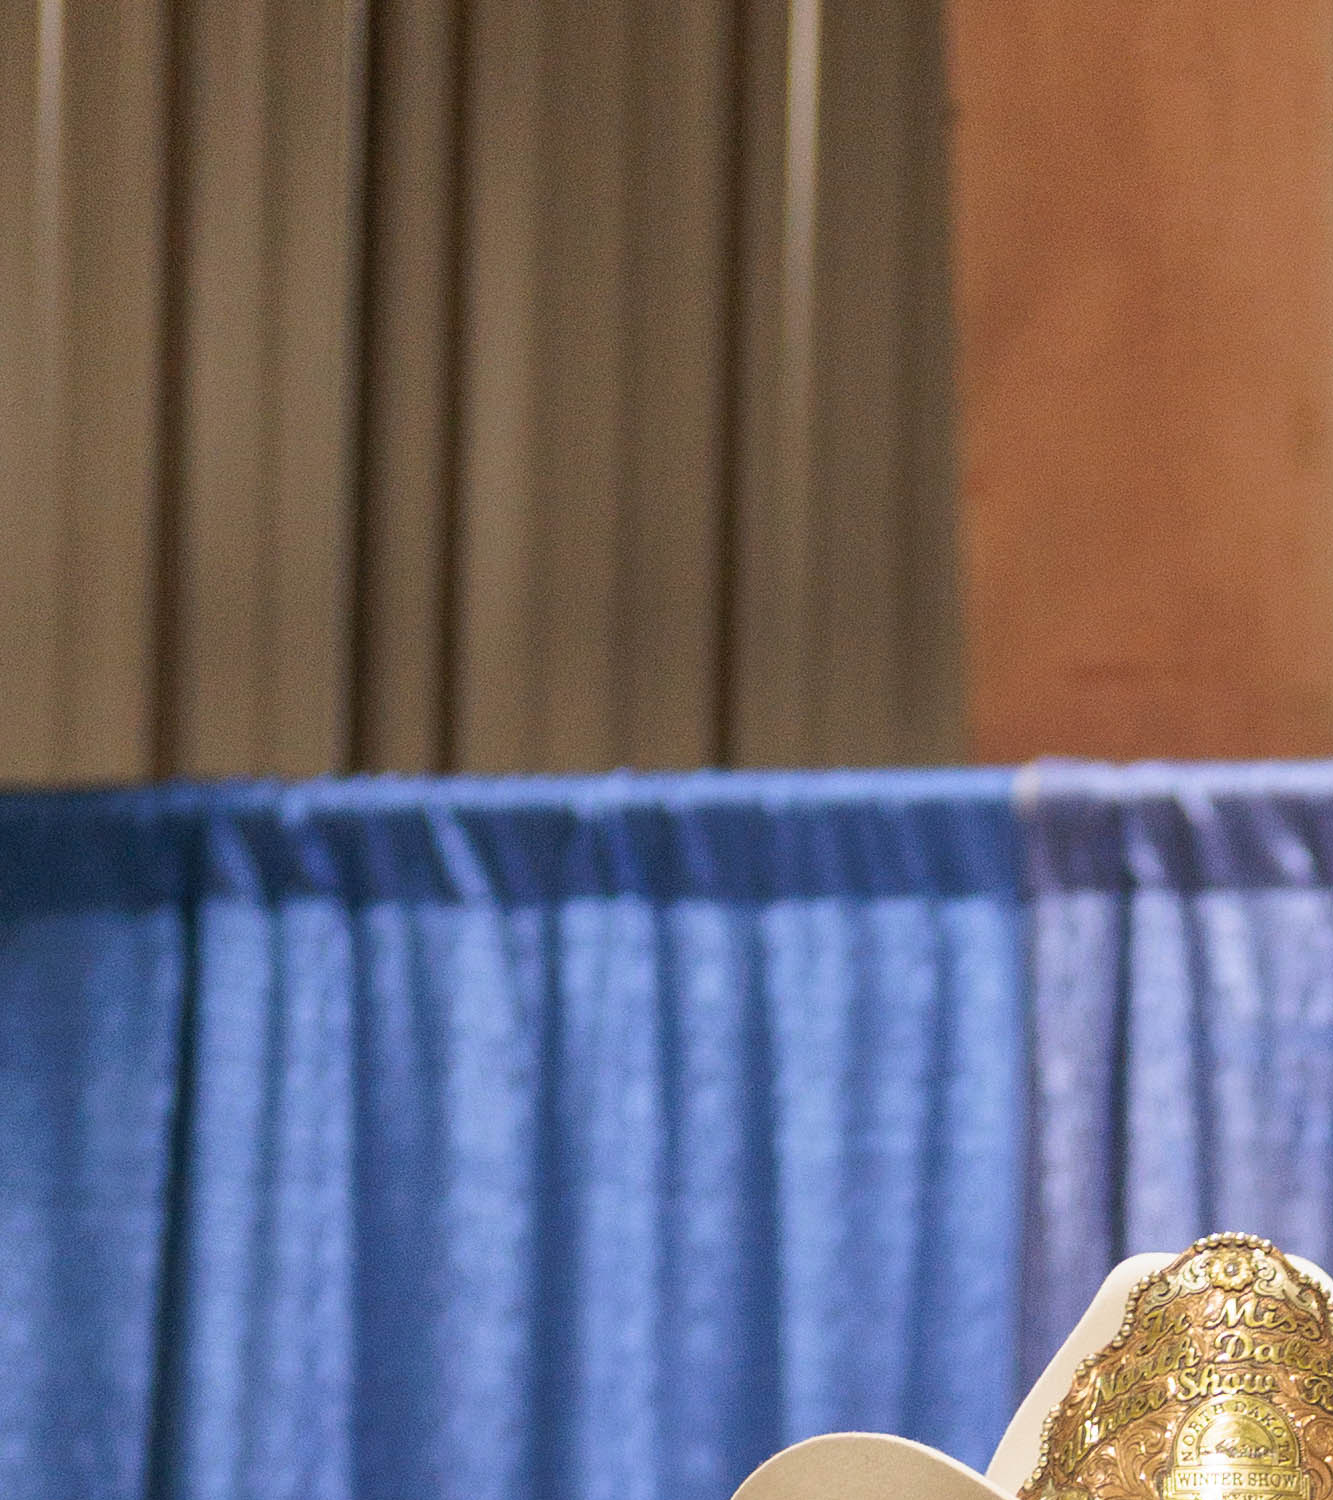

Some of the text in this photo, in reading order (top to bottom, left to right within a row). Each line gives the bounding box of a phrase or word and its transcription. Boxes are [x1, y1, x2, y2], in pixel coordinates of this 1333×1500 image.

[1203, 1297, 1321, 1341] Miss
[1088, 1336, 1200, 1416] North
[1176, 1365, 1280, 1402] Show
[1181, 1400, 1290, 1463] NORTH DAKOTA
[1177, 1472, 1297, 1488] WINTER SHOW
